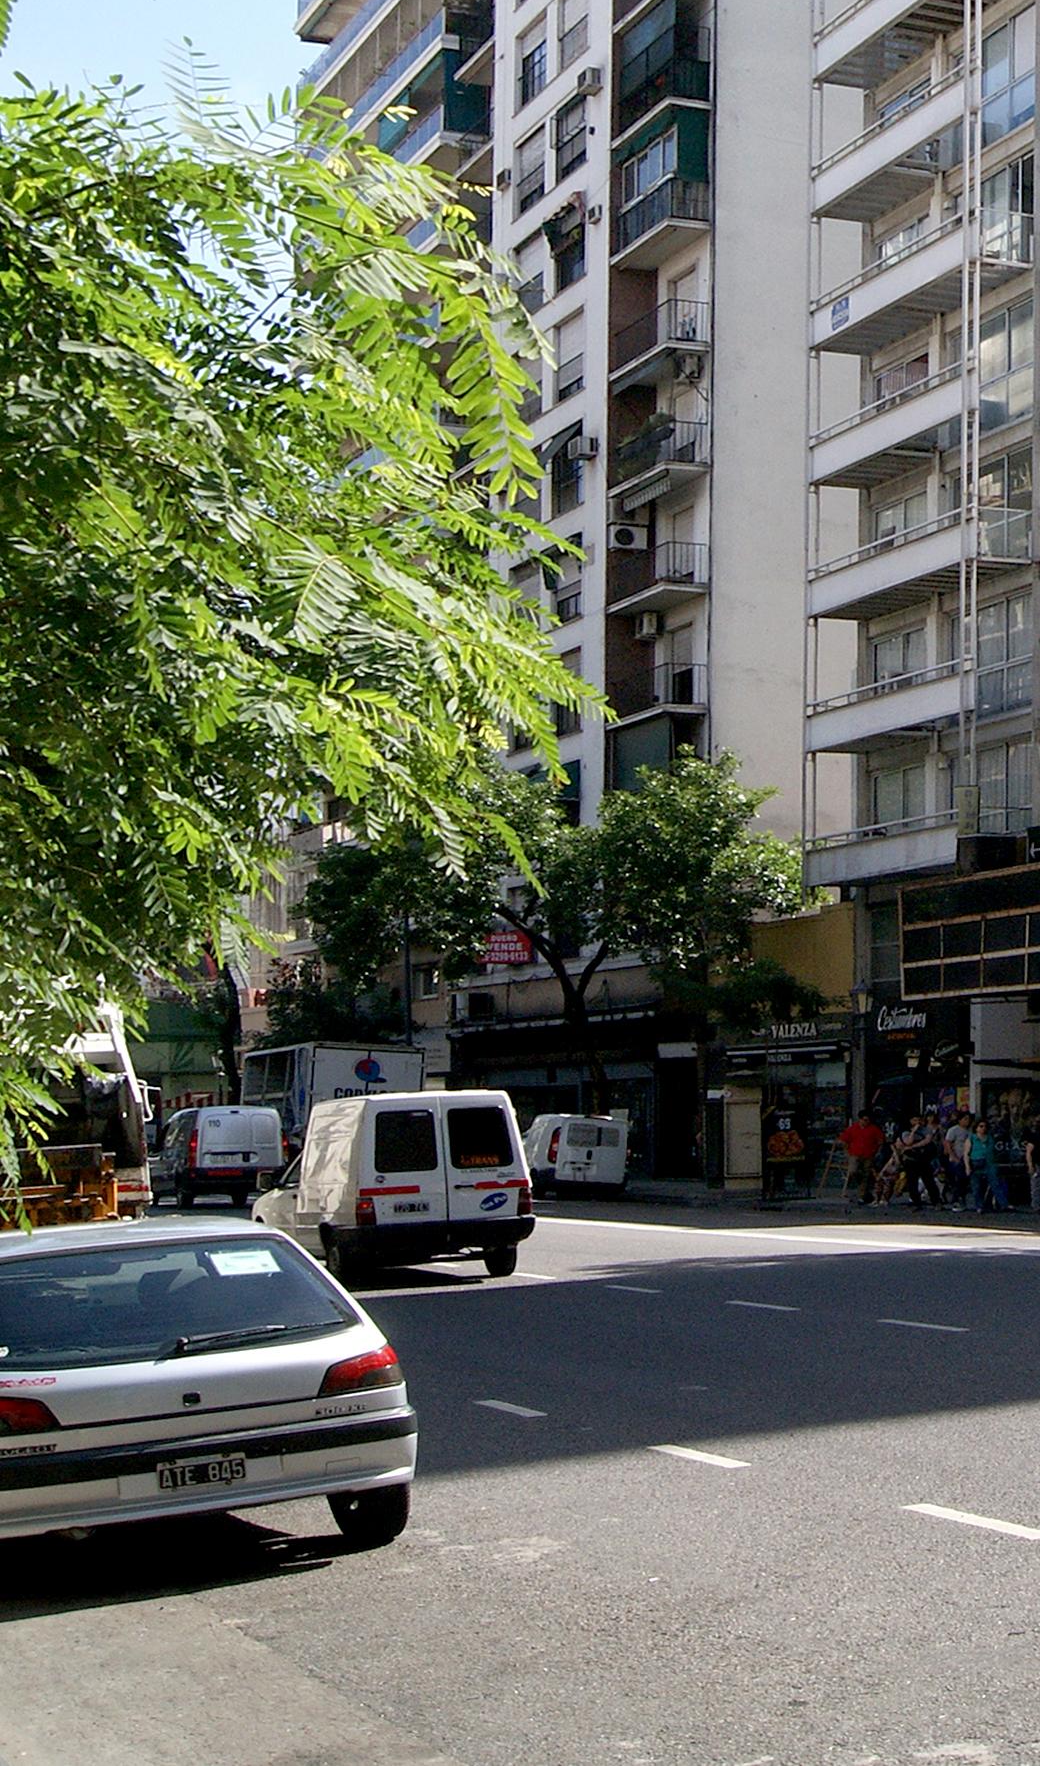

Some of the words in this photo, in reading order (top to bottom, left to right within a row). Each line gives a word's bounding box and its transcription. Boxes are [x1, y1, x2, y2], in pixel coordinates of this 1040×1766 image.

[770, 1022, 817, 1039] VALENZA
[208, 1119, 221, 1128] 110
[161, 1465, 198, 1489] ATE
[208, 1459, 246, 1482] 845
